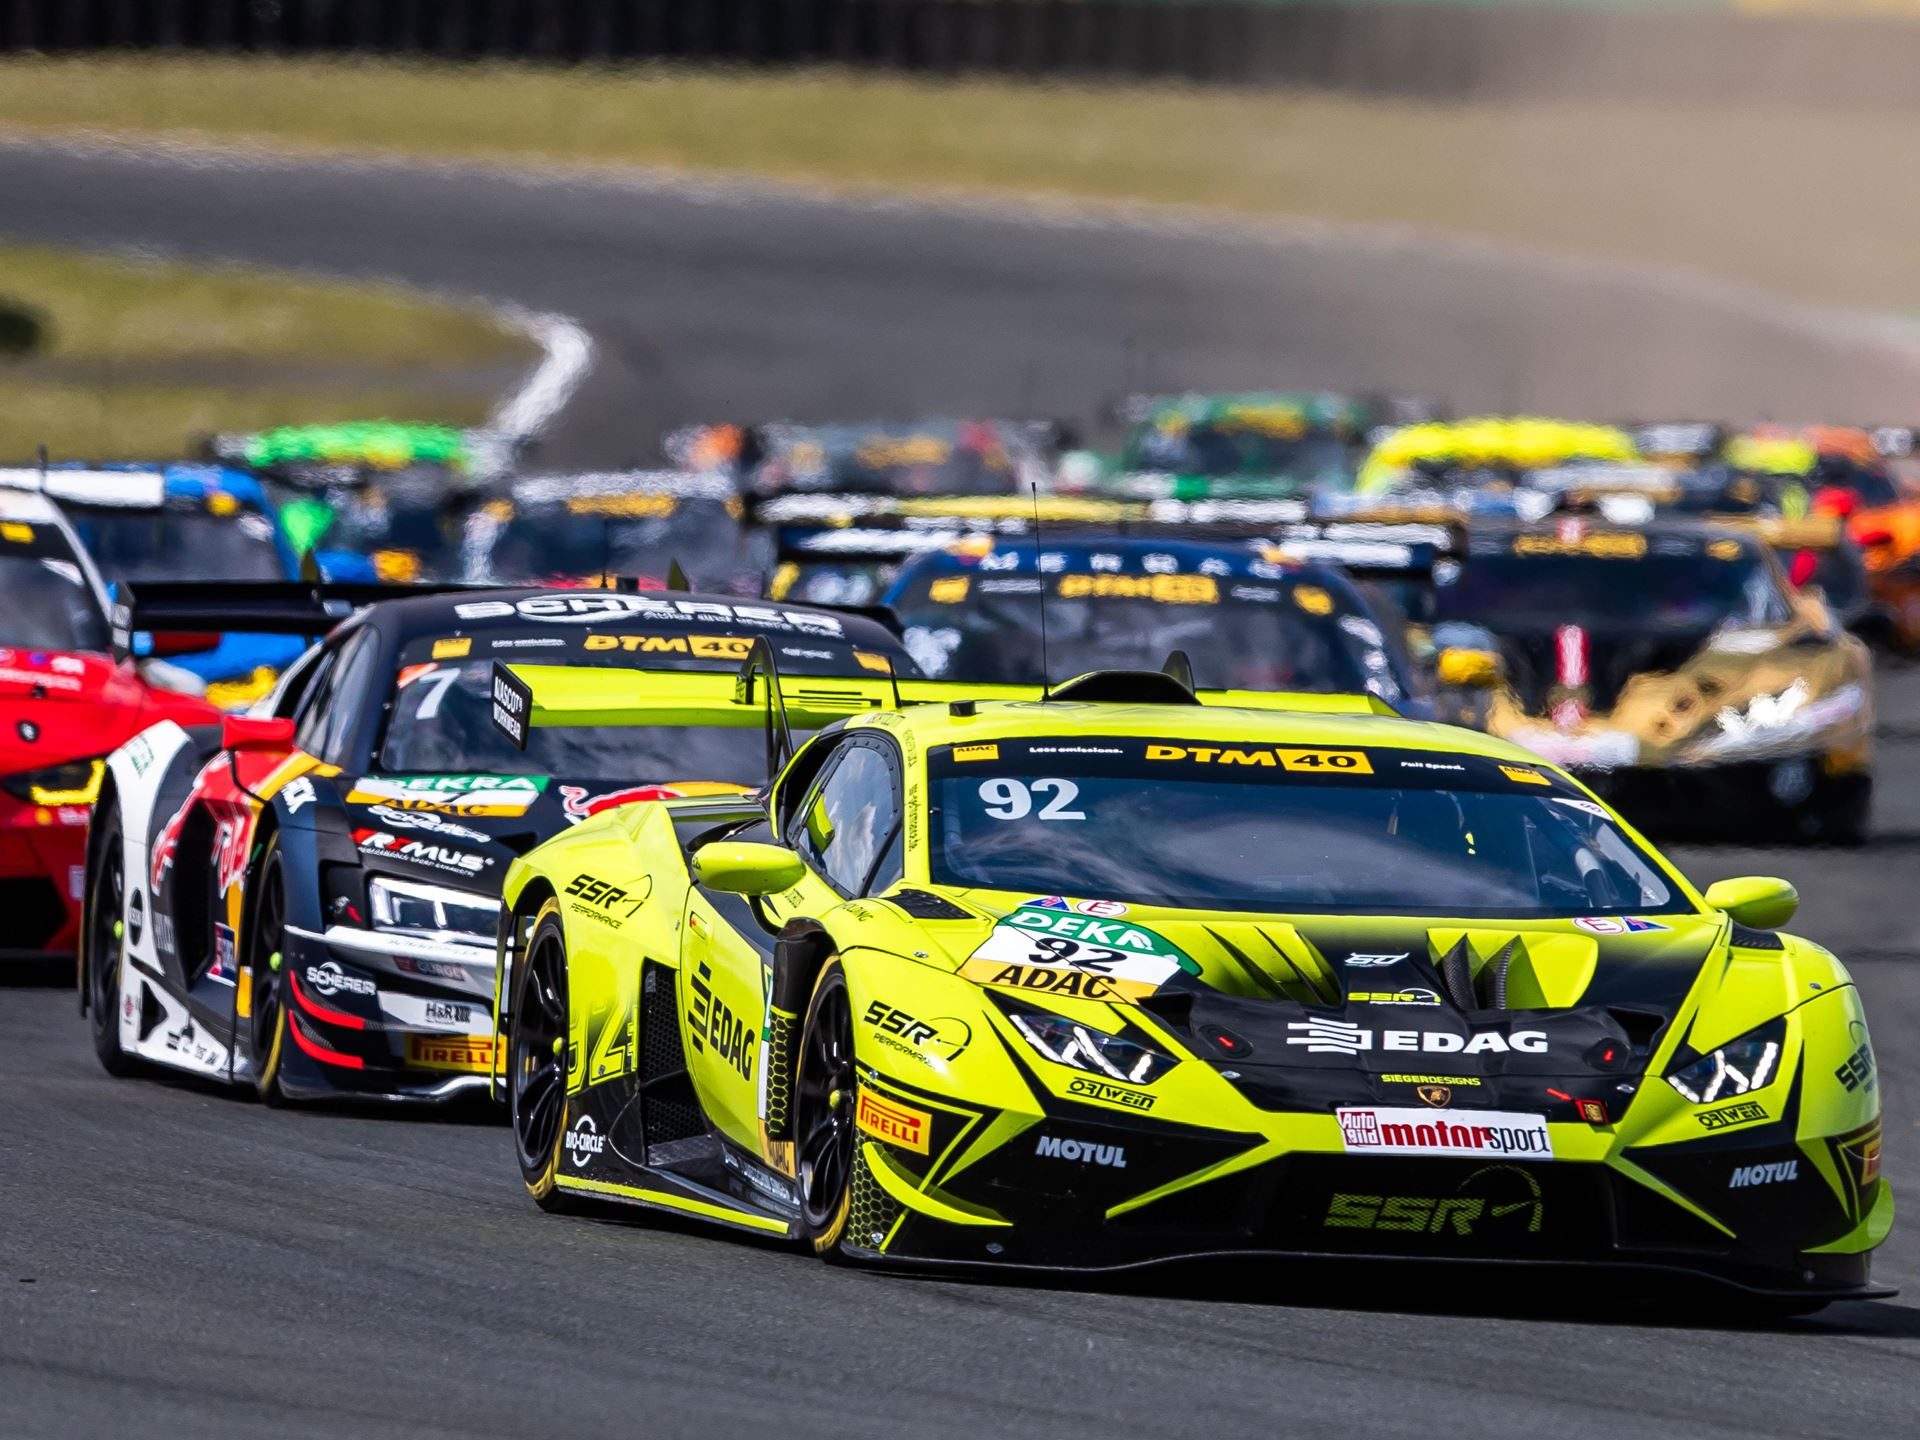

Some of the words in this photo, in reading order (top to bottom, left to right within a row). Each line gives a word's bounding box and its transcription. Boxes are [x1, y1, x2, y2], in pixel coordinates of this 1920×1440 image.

[455, 594, 843, 633] SCHERER
[584, 634, 687, 652] DTM
[700, 641, 750, 656] 40
[415, 668, 461, 720] 7
[956, 745, 994, 753] ADAC
[1145, 745, 1277, 767] DTM
[1292, 754, 1358, 768] 40
[1429, 762, 1465, 771] Speed.
[978, 777, 1087, 820] 92
[564, 873, 628, 910] SSR
[569, 902, 623, 931] PERFORMANCE
[1028, 937, 1129, 973] 92
[306, 962, 378, 996] SCHERER
[990, 964, 1118, 999] ADAC
[1348, 992, 1415, 1002] SSR
[710, 995, 756, 1082] EDAG
[863, 1000, 940, 1046] SSR
[872, 1031, 943, 1071] PERFORMAN
[1383, 1030, 1549, 1054] EDAG
[1381, 1073, 1481, 1087] SIEGERDESIGNS
[860, 1094, 921, 1145] PIRELLI
[1342, 1112, 1375, 1129] Auto
[565, 1130, 605, 1153] BIO-CIRCLE
[1035, 1136, 1127, 1168] MOTUL
[1345, 1129, 1379, 1144] Bild
[1728, 1160, 1799, 1188] MOTUL
[1324, 1193, 1487, 1236] SSR
